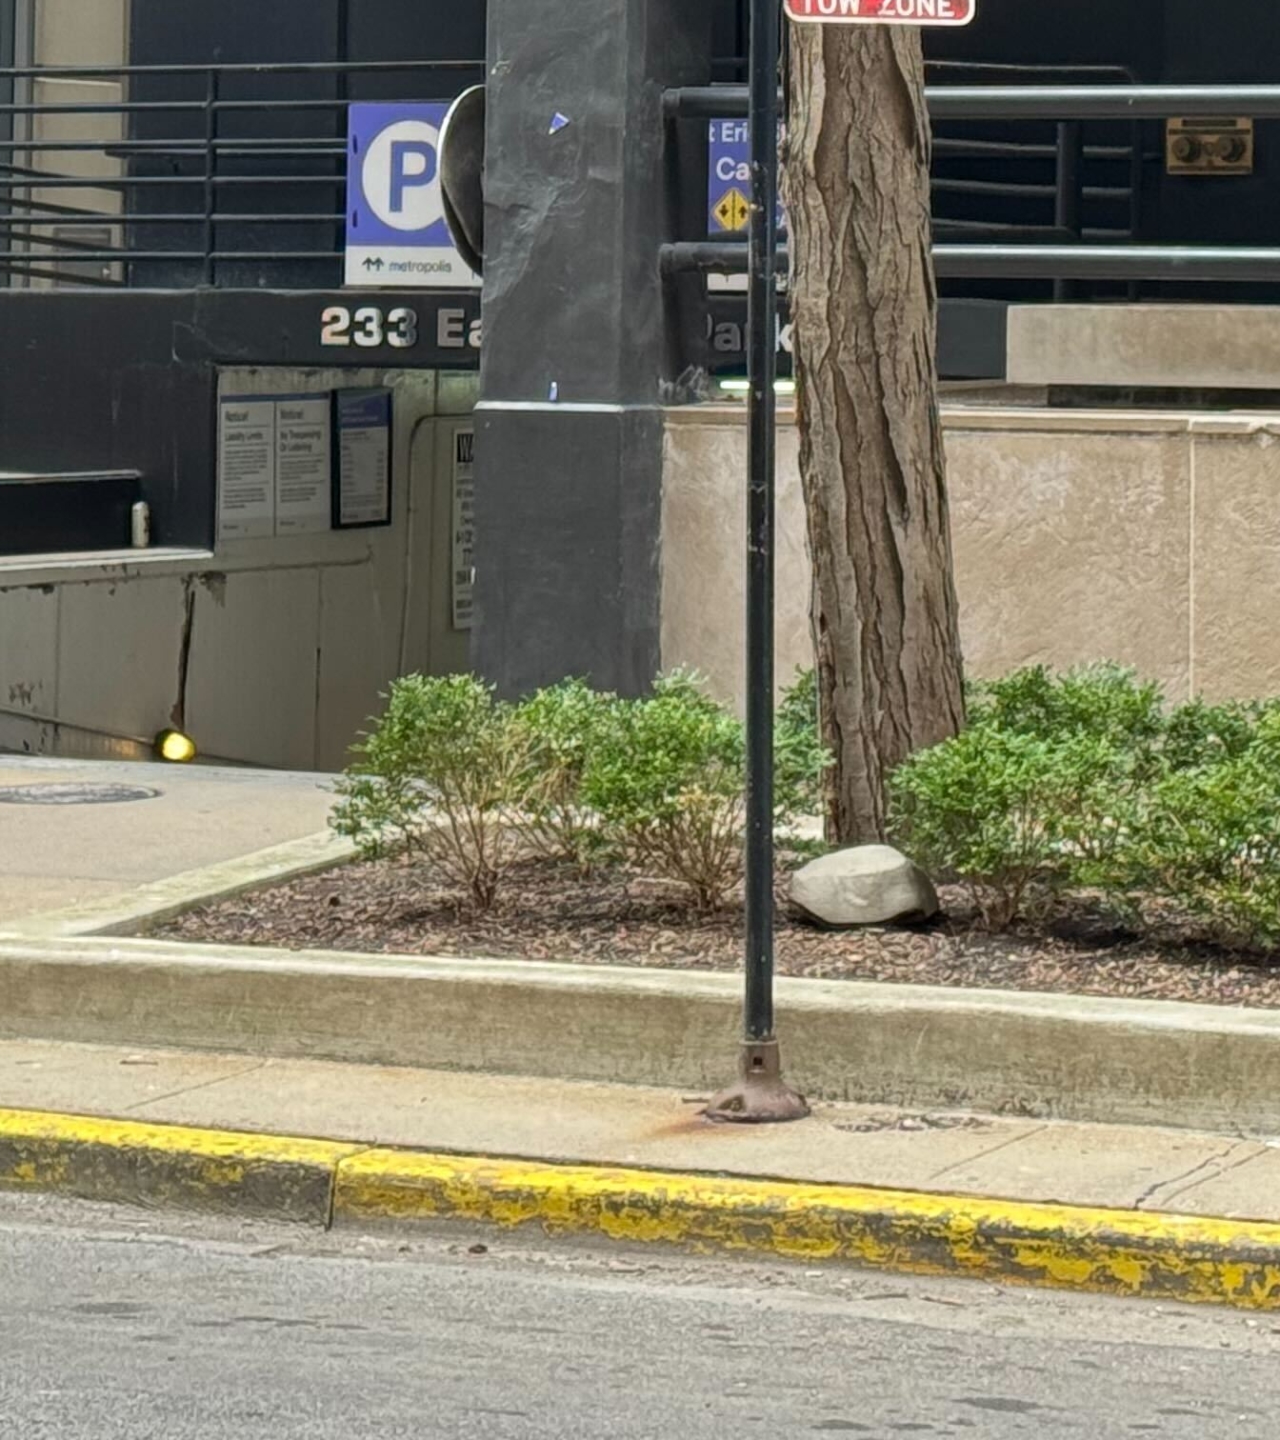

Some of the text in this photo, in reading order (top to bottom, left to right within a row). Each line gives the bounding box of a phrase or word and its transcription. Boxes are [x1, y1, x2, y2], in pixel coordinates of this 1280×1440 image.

[721, 122, 750, 143] Eri
[389, 260, 452, 274] metropolis
[321, 306, 418, 348] 233
